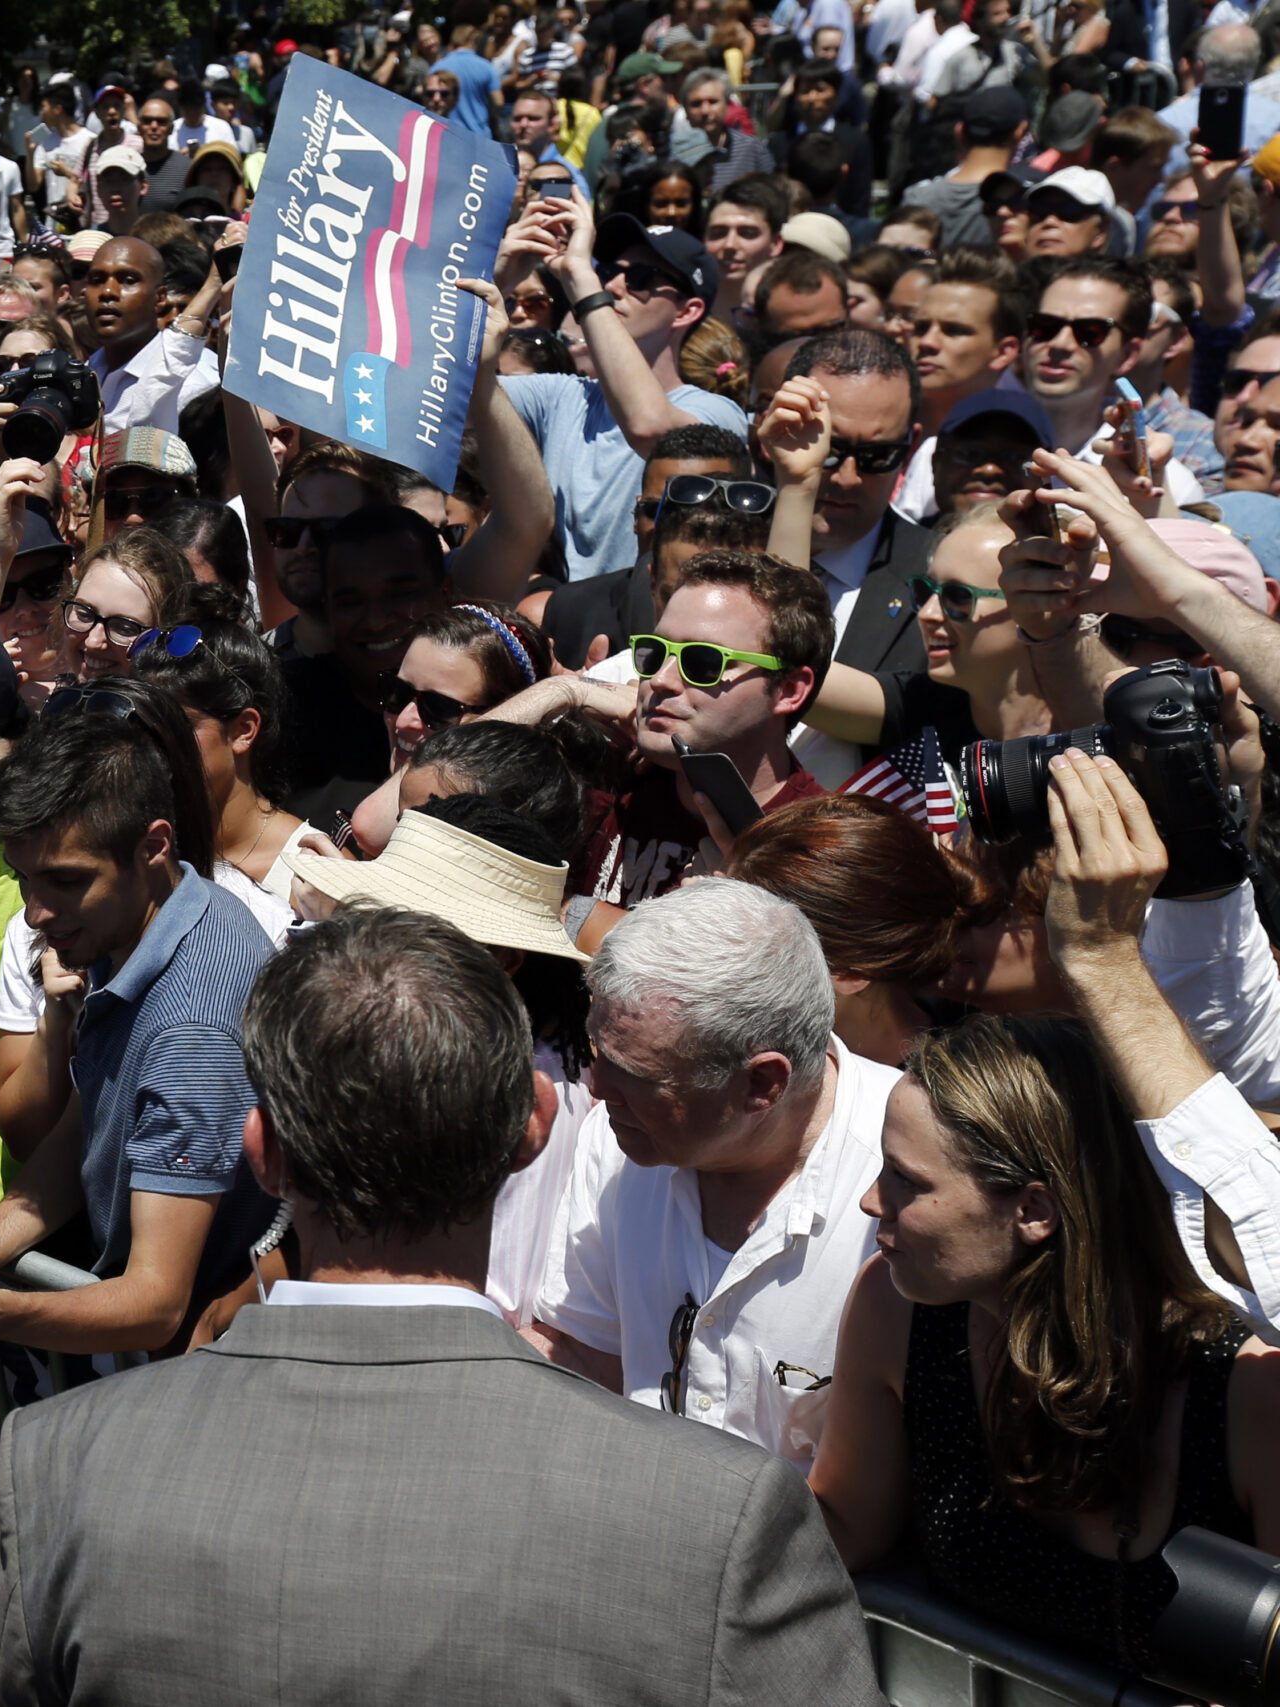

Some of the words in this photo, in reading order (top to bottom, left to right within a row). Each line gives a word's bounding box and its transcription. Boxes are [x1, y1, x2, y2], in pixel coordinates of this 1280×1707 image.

[277, 207, 305, 242] for
[286, 89, 333, 198] President
[257, 100, 407, 405] Hillary
[416, 163, 489, 448] HillaryClinton.com
